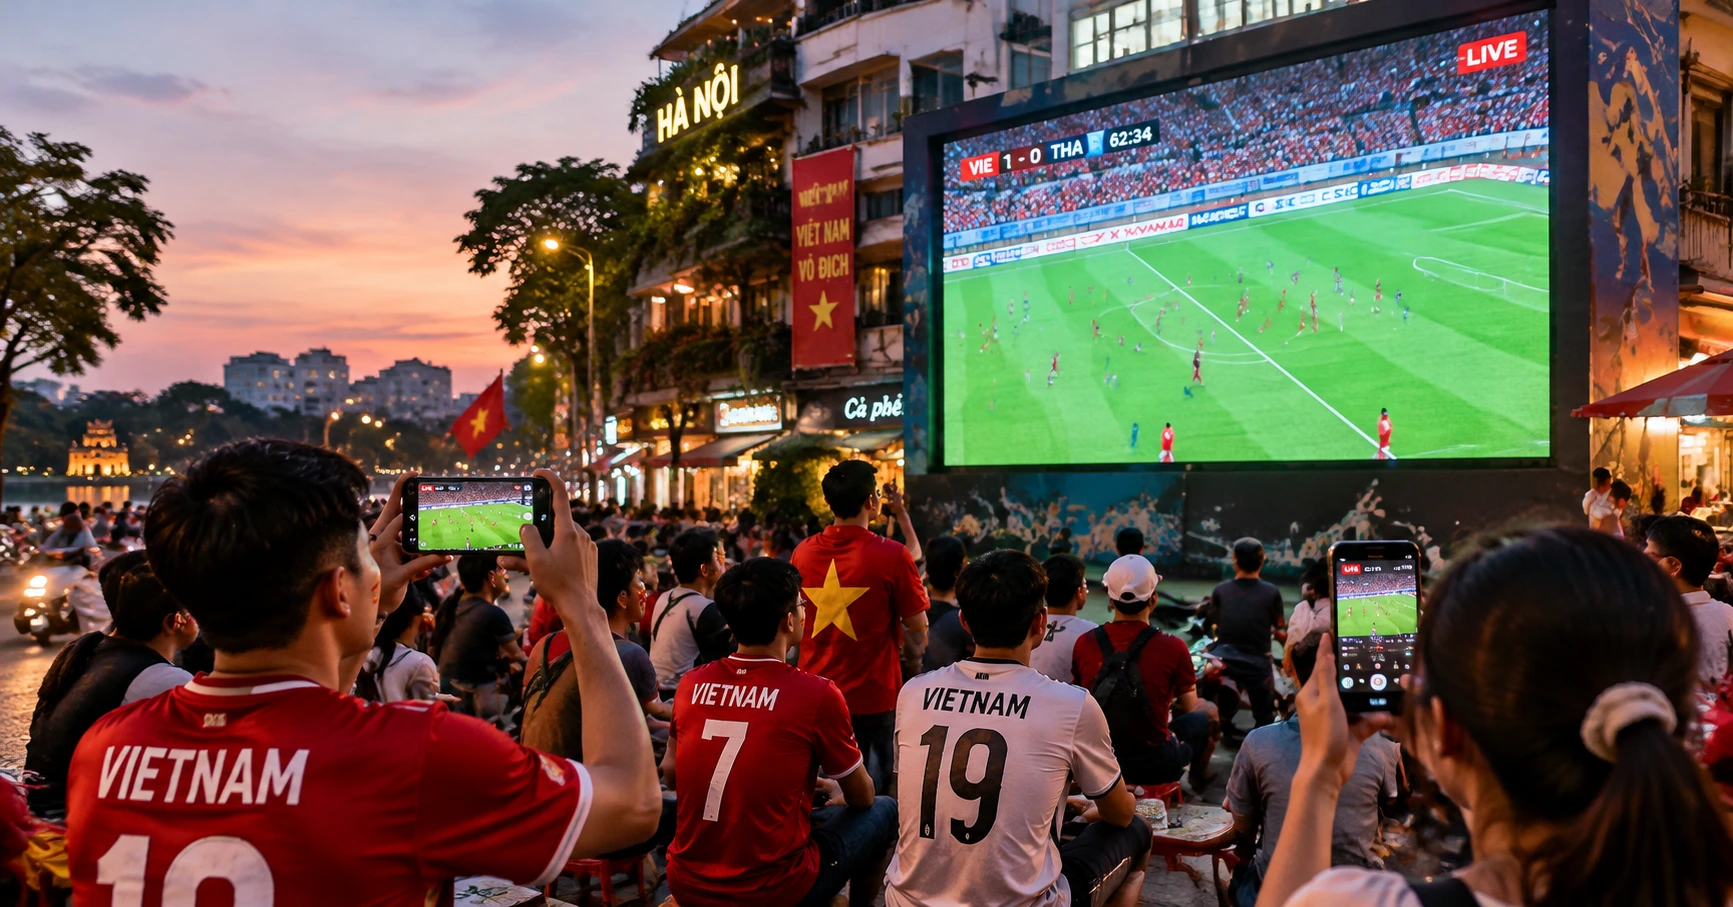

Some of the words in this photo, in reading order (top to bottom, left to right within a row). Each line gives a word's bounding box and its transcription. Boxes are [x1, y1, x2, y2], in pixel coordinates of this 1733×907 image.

[657, 86, 690, 143] HÀ
[694, 63, 738, 124] NỘI
[969, 158, 994, 175] VIE
[1002, 153, 1012, 170] 1
[1029, 147, 1042, 164] 0
[1050, 139, 1084, 160] THA
[1109, 126, 1153, 148] 62:34
[824, 217, 850, 244] NAM
[691, 683, 780, 712] VIETNAM
[922, 687, 1031, 720] VIETNAM
[98, 745, 309, 806] VIETNAM
[701, 718, 749, 823] 7
[918, 724, 1008, 845] 19
